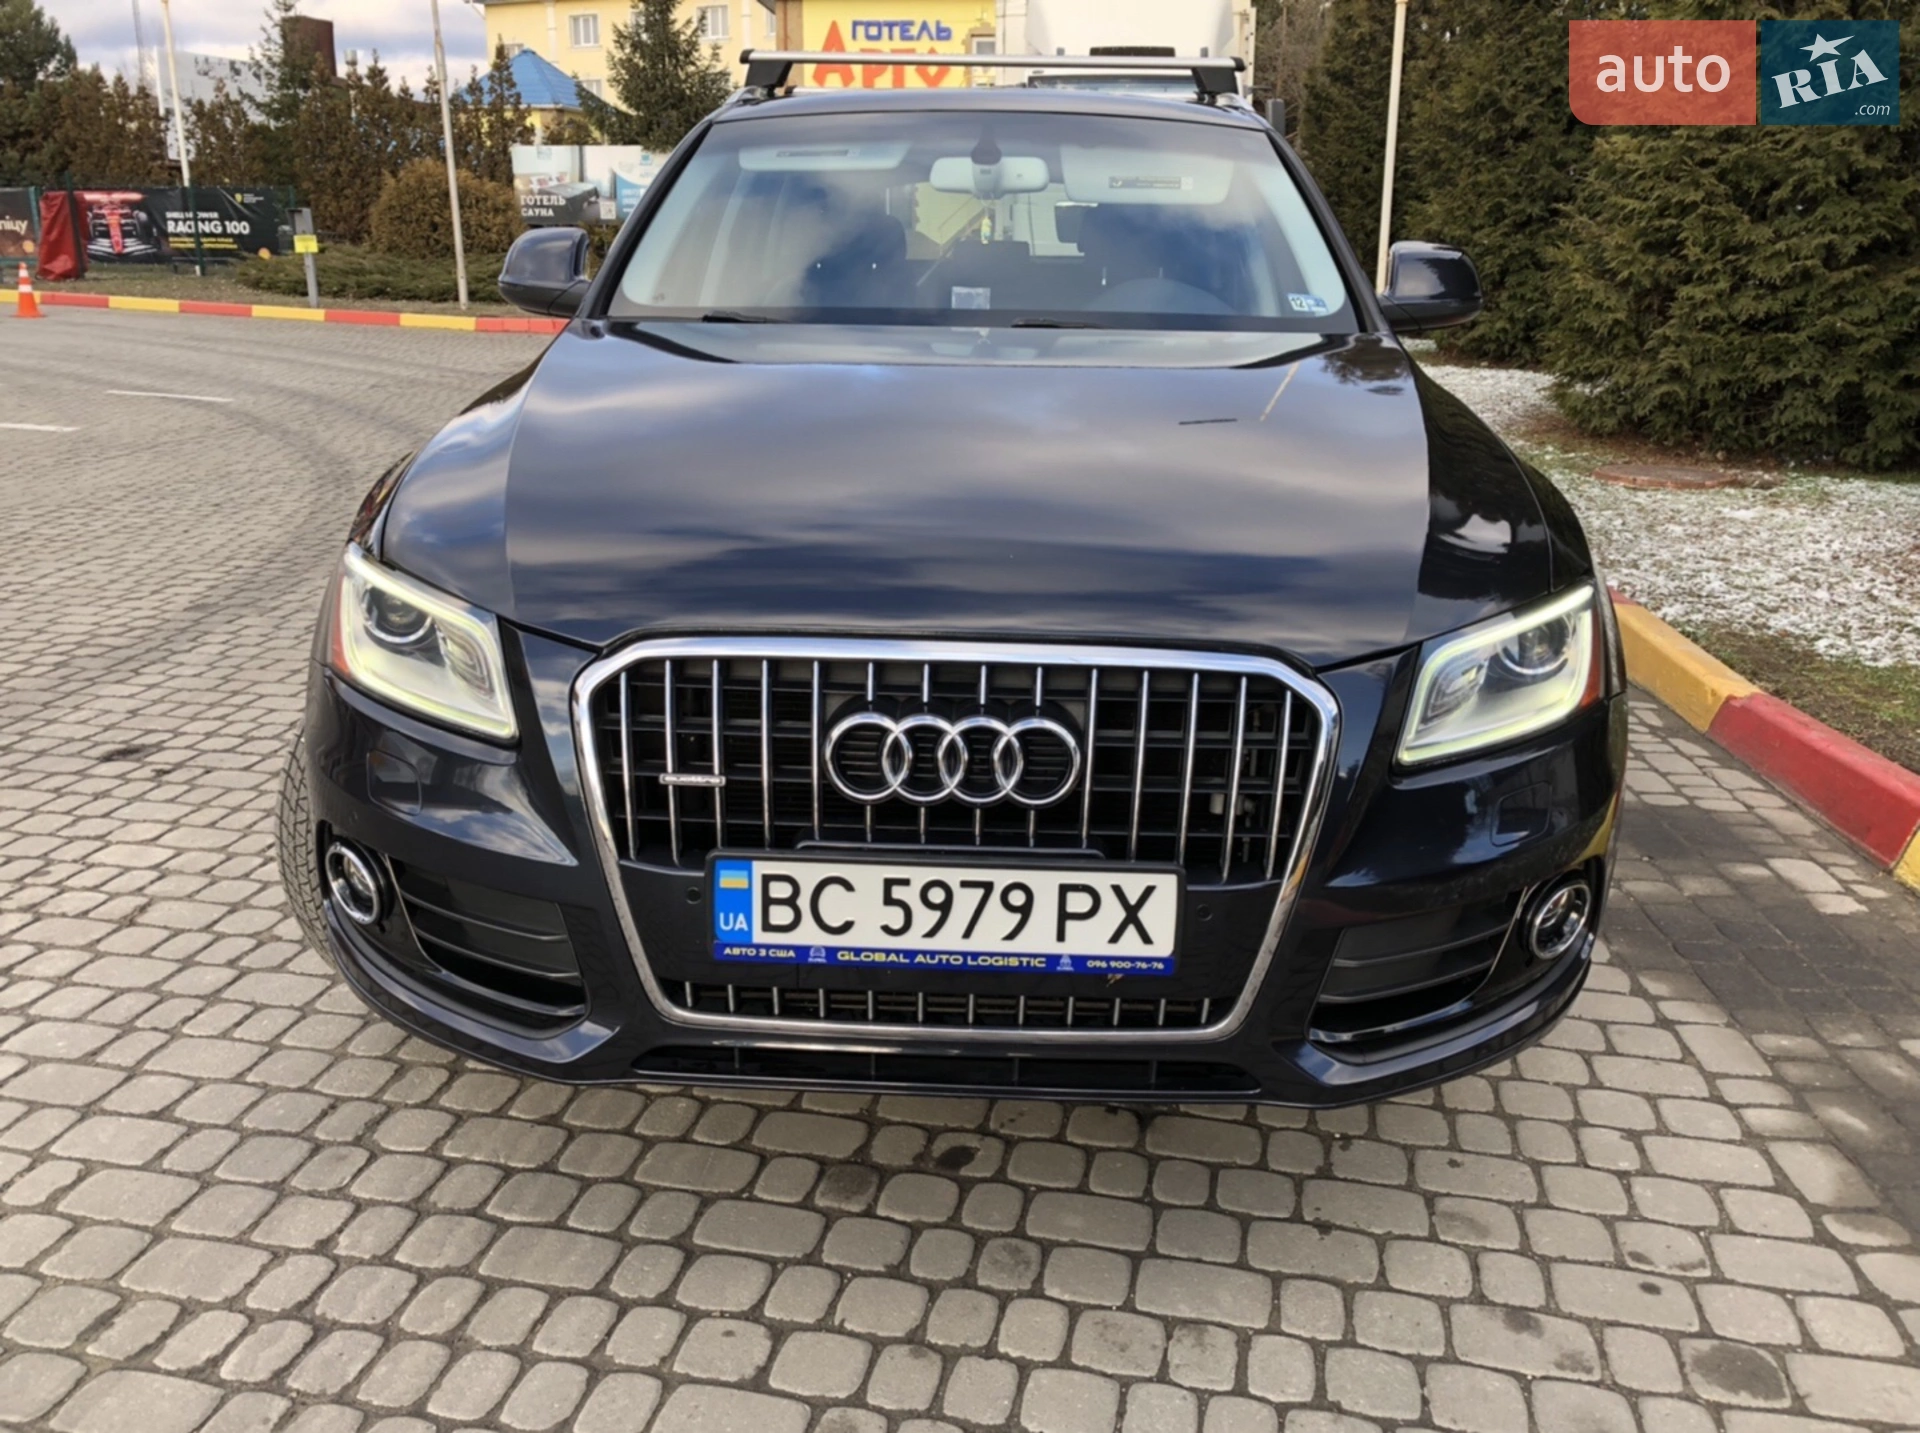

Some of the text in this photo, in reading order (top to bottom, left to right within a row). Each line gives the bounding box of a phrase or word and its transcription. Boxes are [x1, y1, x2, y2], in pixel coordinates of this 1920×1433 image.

[852, 20, 952, 41] ГОТЕЛЬ
[520, 195, 566, 206] ГОТЕЛЬ
[521, 208, 554, 217] САУНА
[224, 221, 250, 235] 100
[761, 873, 1157, 945] BC 5979 PX
[719, 912, 748, 932] UA
[723, 947, 756, 956] АВТО
[768, 949, 796, 958] США
[837, 951, 910, 963] GLOBAL
[914, 953, 963, 965] AUTO
[967, 956, 1046, 967] LOGISTIC
[1086, 960, 1164, 970] 096 900-76-76
